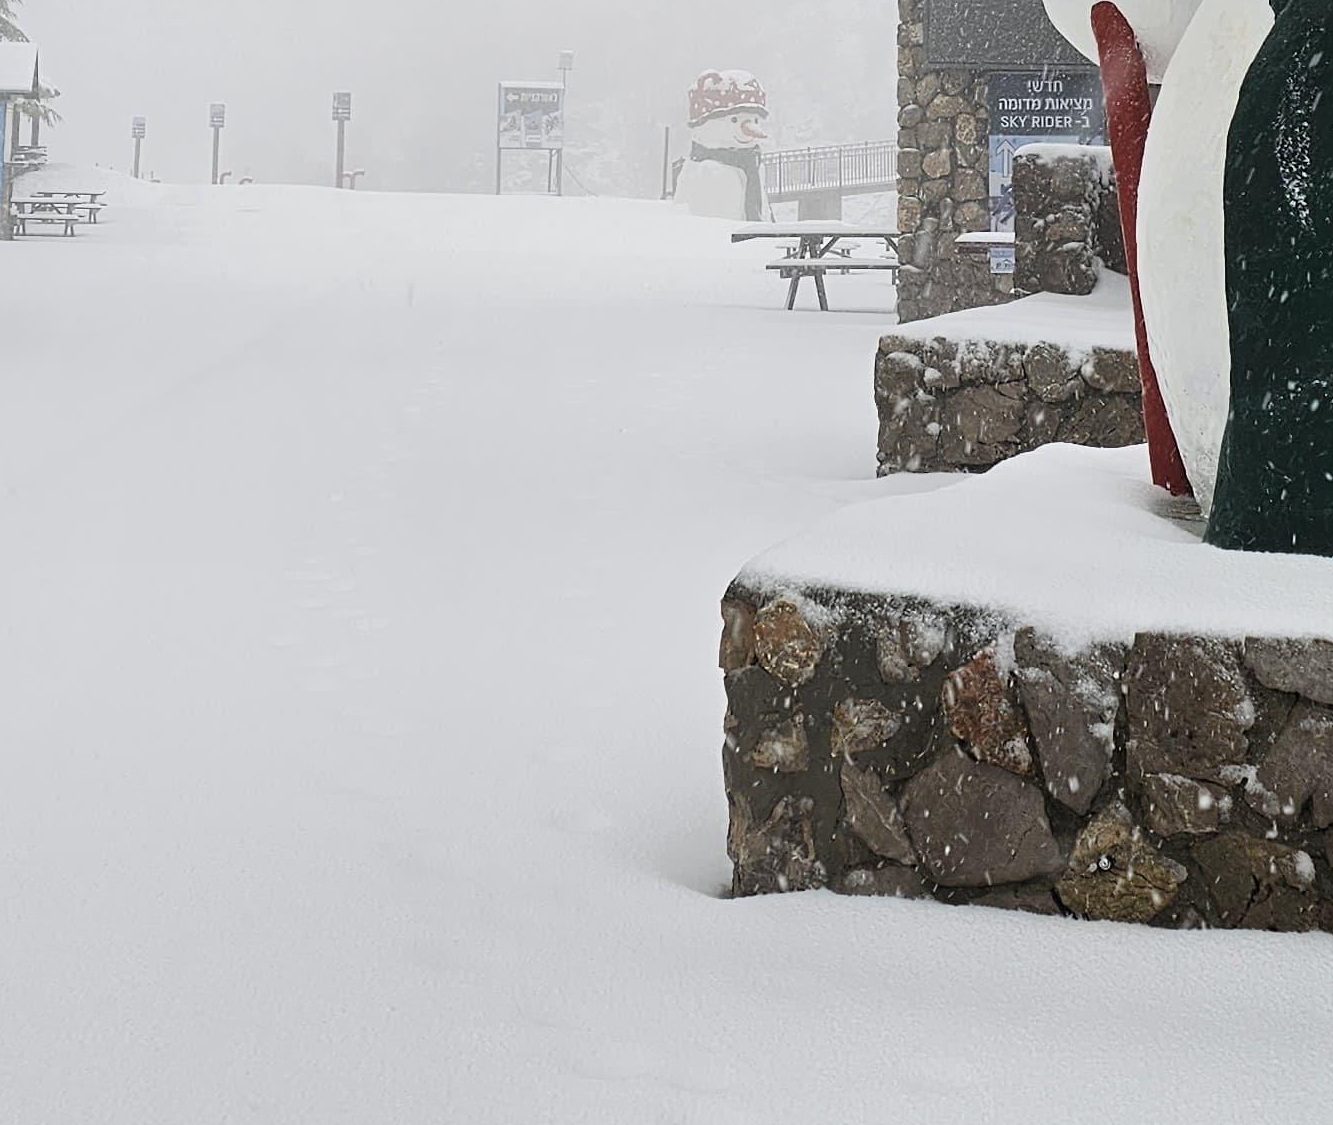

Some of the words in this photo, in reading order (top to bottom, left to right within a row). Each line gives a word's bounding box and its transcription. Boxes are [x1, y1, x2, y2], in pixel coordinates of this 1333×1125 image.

[1027, 79, 1063, 93] חדש!
[998, 97, 1042, 111] מדומה
[1044, 97, 1093, 111] מציאות
[1000, 115, 1028, 128] SKY
[1031, 115, 1073, 128] RIDER
